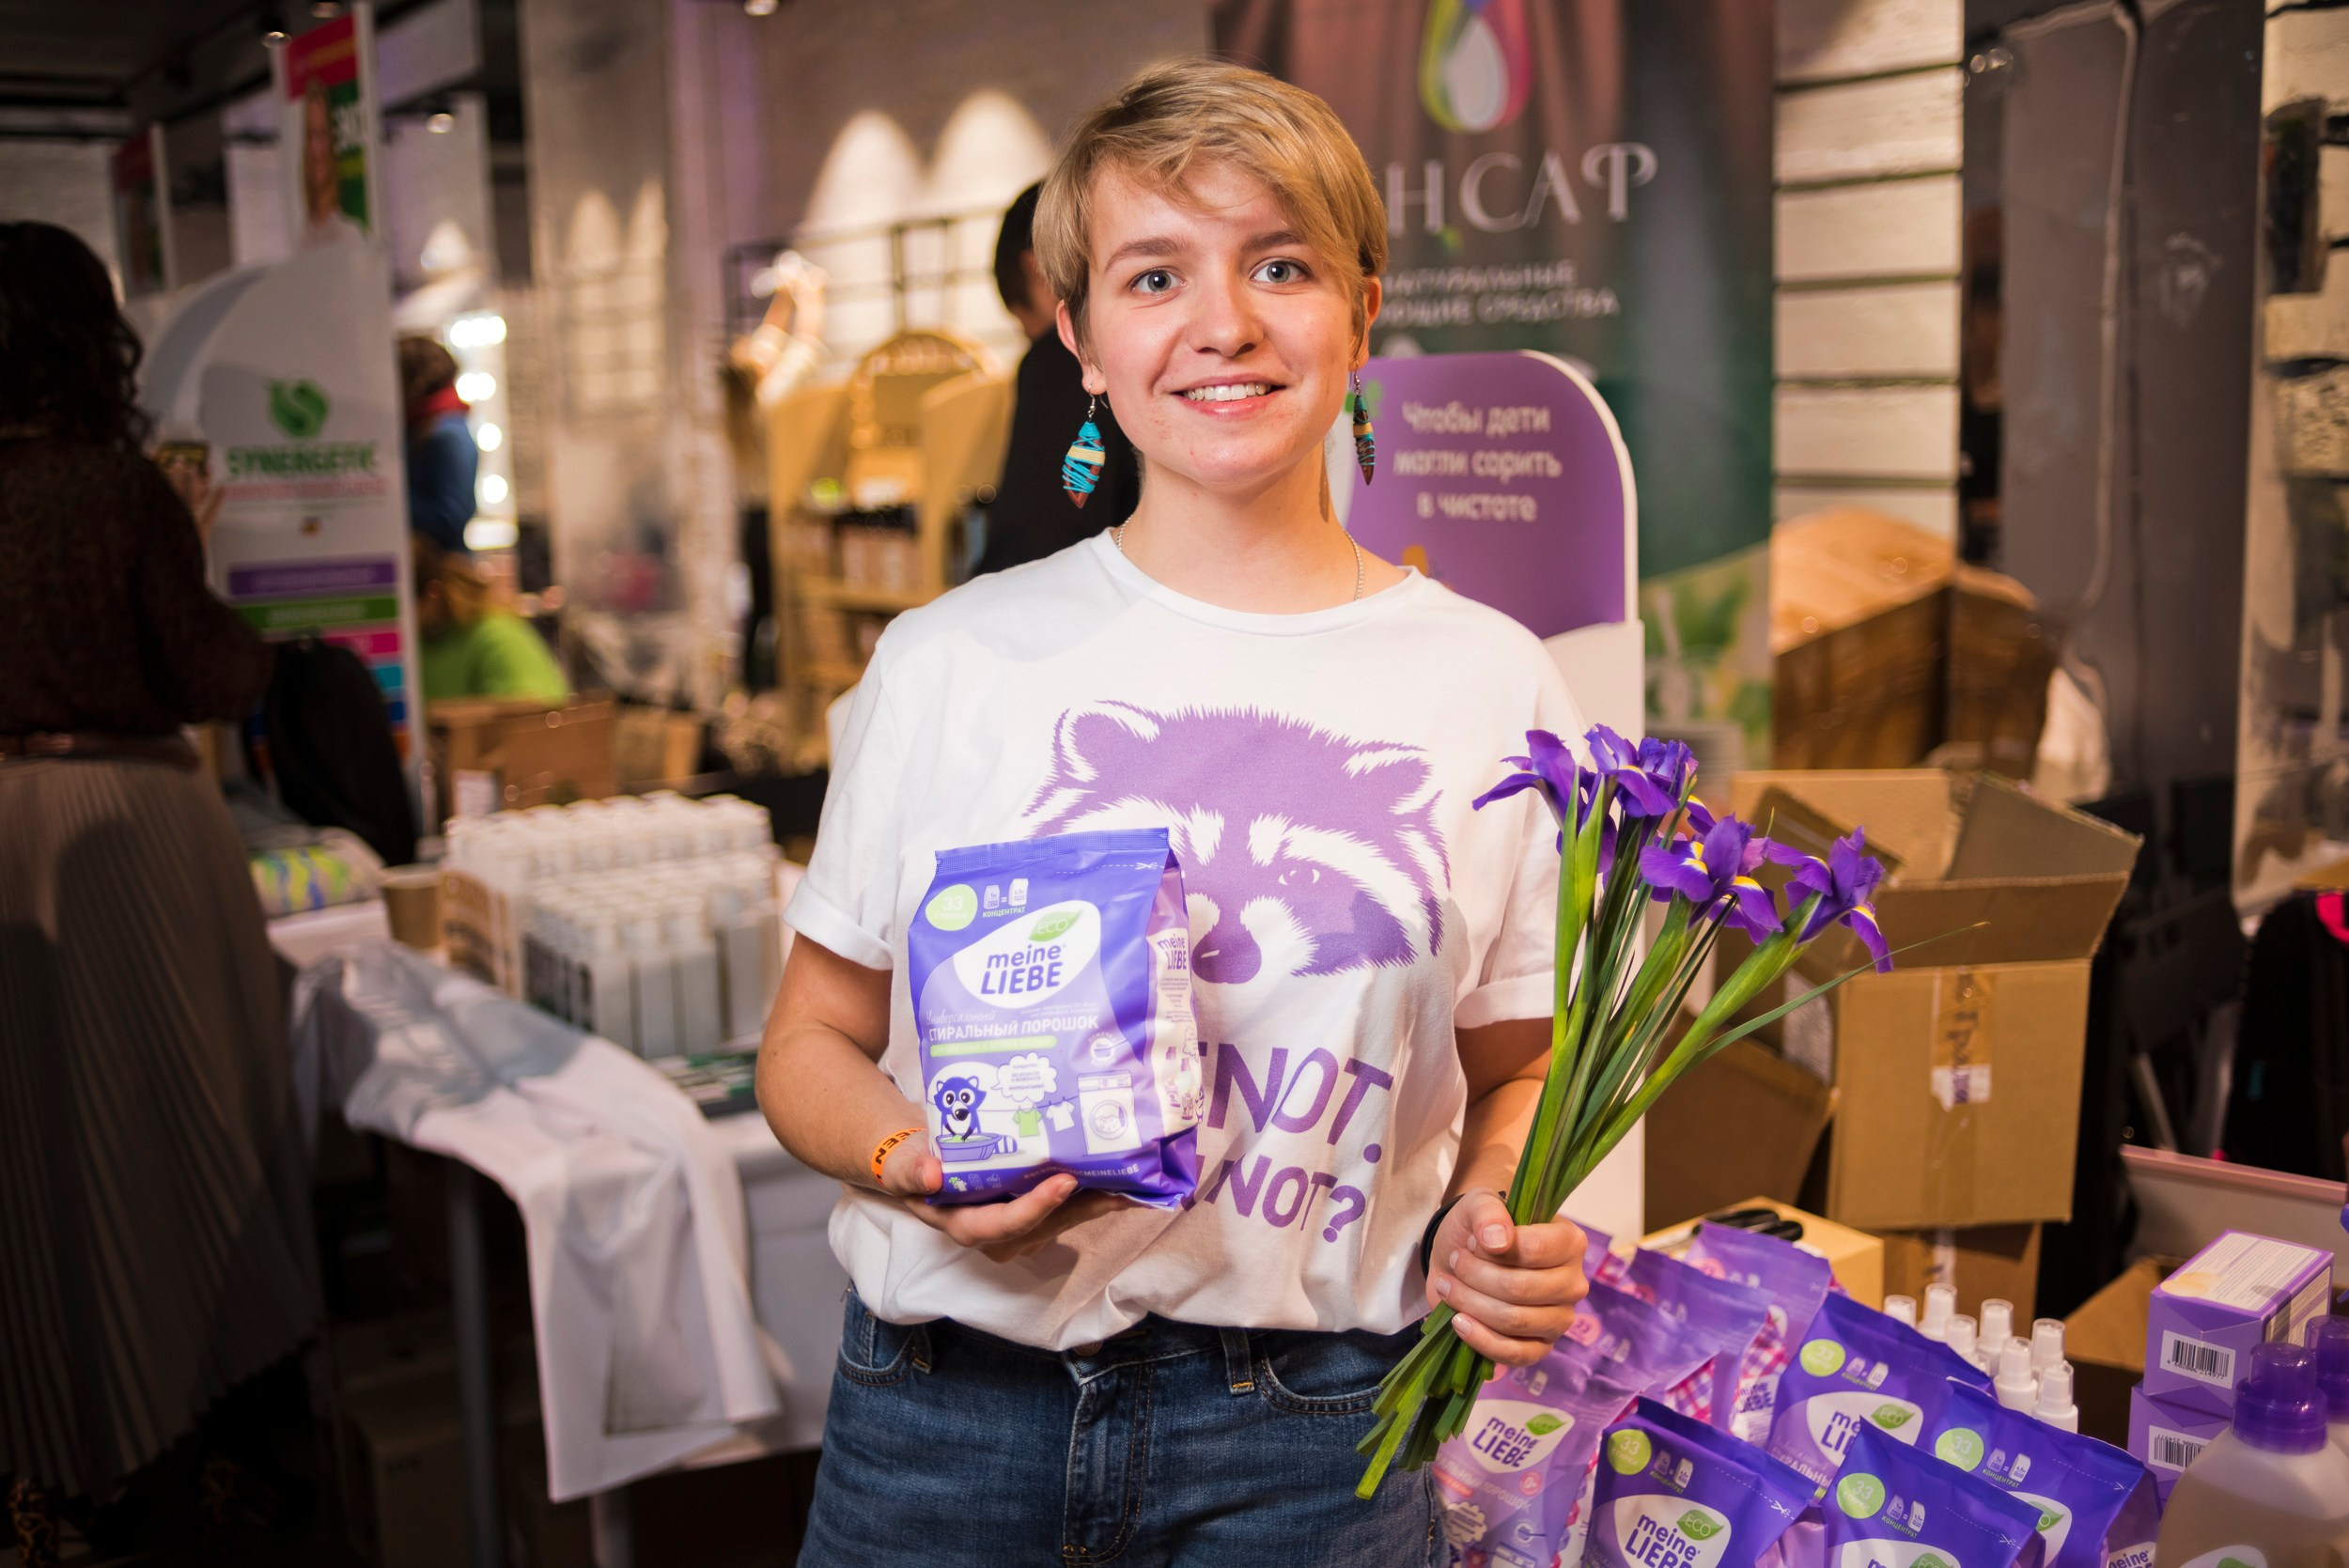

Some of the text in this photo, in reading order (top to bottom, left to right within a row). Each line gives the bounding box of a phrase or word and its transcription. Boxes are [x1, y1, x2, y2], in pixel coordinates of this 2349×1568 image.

[1385, 141, 1658, 236] НСАР
[1402, 400, 1550, 440] Чтобы дети
[1394, 450, 1563, 485] могли сорить
[1438, 491, 1537, 521] чистоте
[942, 895, 964, 910] 33
[982, 907, 1026, 918] КОНЦЕНТРАТ
[1038, 918, 1068, 935] ECO
[987, 944, 1062, 969] meine
[980, 961, 1064, 995] LIEBE
[929, 1015, 1099, 1042] СТИРАЛЬНЫЙ ПОРОШОК
[1198, 1041, 1394, 1165] NOT.
[1879, 1407, 1905, 1426] ECO
[1486, 1417, 1538, 1450] meine
[1620, 1436, 1641, 1455] 33
[1953, 1436, 1972, 1454] 33
[1472, 1428, 1532, 1467] LIEBE
[1853, 1481, 1874, 1499] 33
[1982, 1467, 2020, 1488] КОНЦЕНТРАТ
[1637, 1514, 1697, 1560] meine
[1685, 1514, 1711, 1537] ECO
[1881, 1515, 1918, 1539] КОНЦЕНТРАТ
